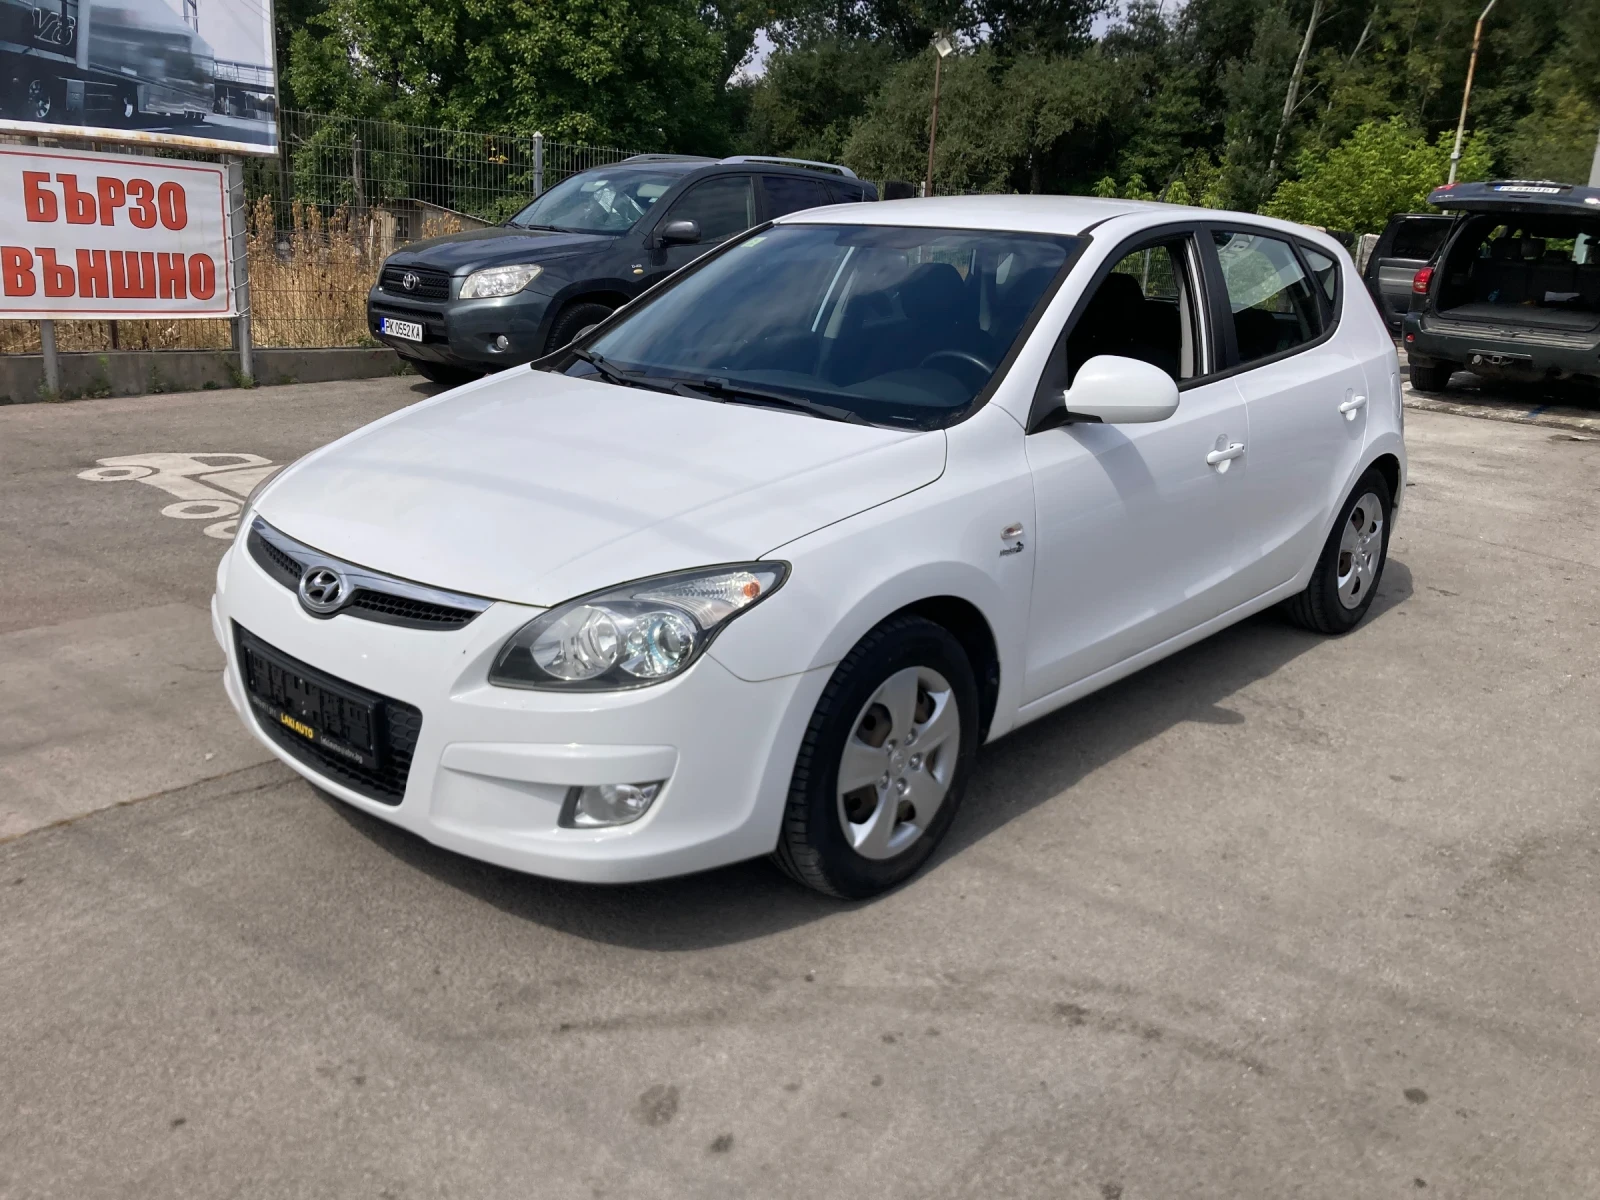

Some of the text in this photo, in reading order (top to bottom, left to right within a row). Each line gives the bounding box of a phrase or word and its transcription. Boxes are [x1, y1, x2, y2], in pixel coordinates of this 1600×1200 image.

[22, 171, 188, 231] БЪРЗО
[1, 246, 216, 300] ВЪНШНО
[281, 712, 314, 739] LAKI AUTO
